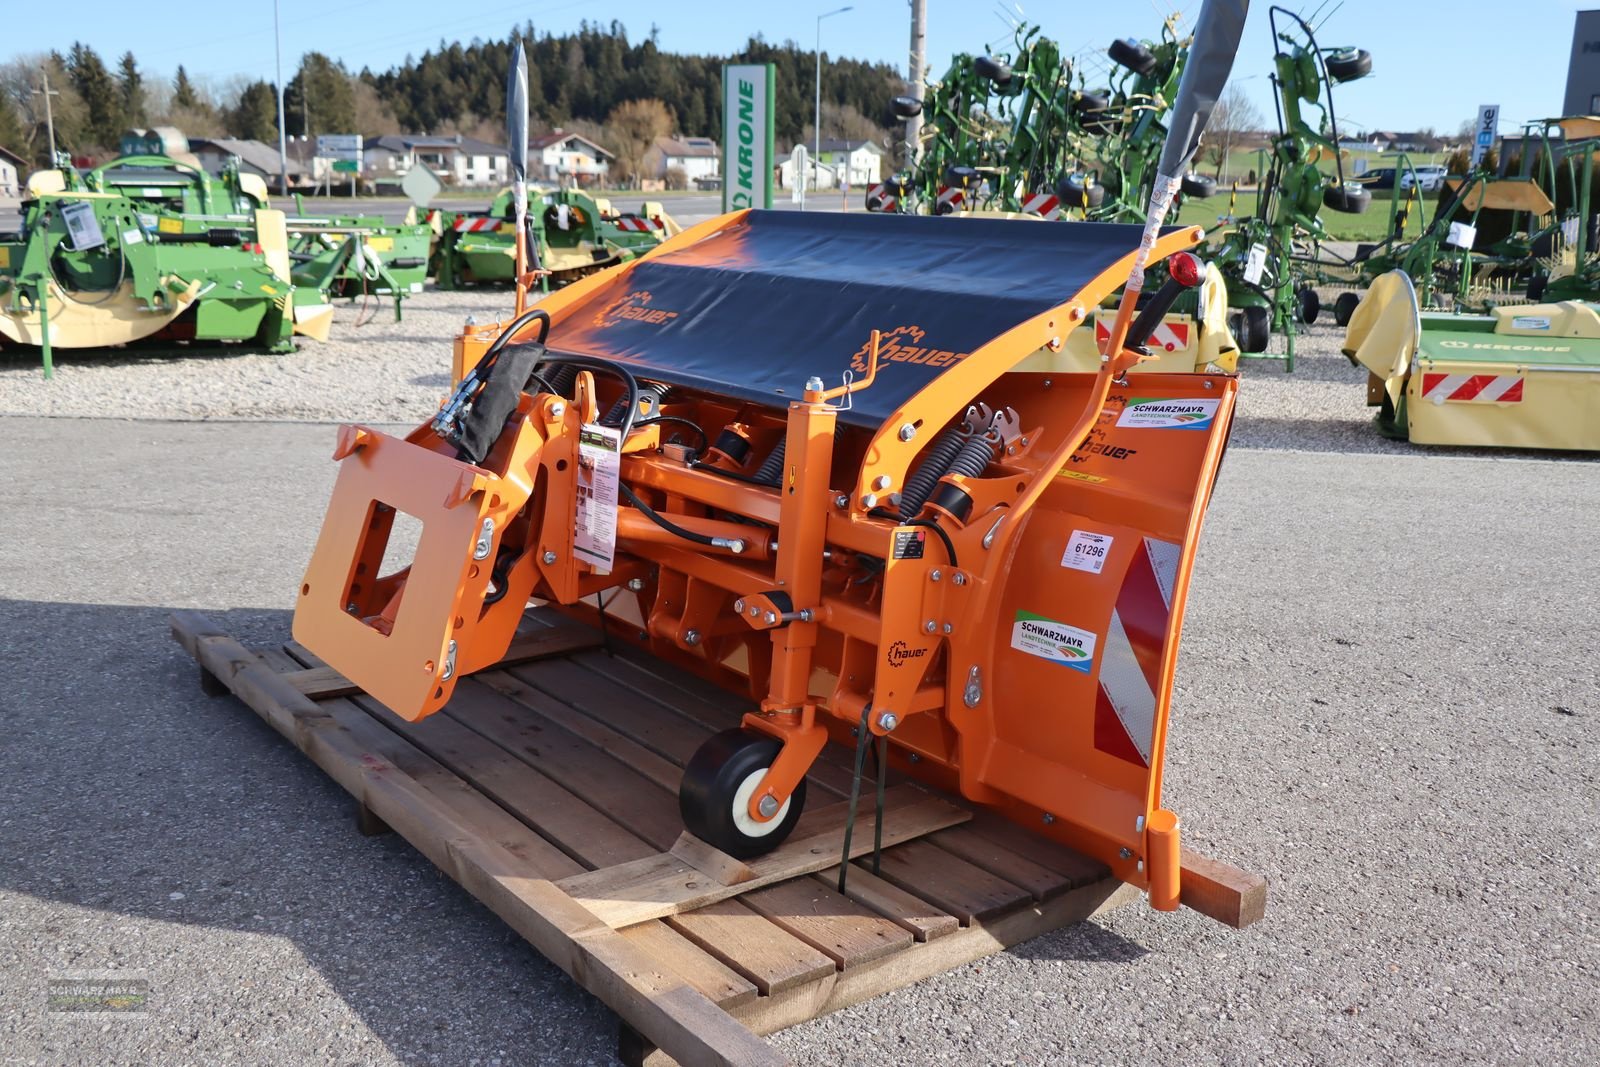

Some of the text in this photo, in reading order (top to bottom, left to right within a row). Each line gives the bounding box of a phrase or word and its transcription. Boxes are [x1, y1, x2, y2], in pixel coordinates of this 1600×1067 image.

[738, 79, 754, 190] KRONE
[609, 300, 678, 325] hauer
[1472, 342, 1571, 352] KRONE
[1133, 405, 1204, 413] SCHWARZMAYR
[1078, 436, 1136, 460] hauer
[1075, 543, 1104, 557] 61296
[1021, 621, 1083, 648] SCHWARZMAYR
[1021, 631, 1057, 648] LANDTECHNIK
[894, 647, 928, 659] hauer
